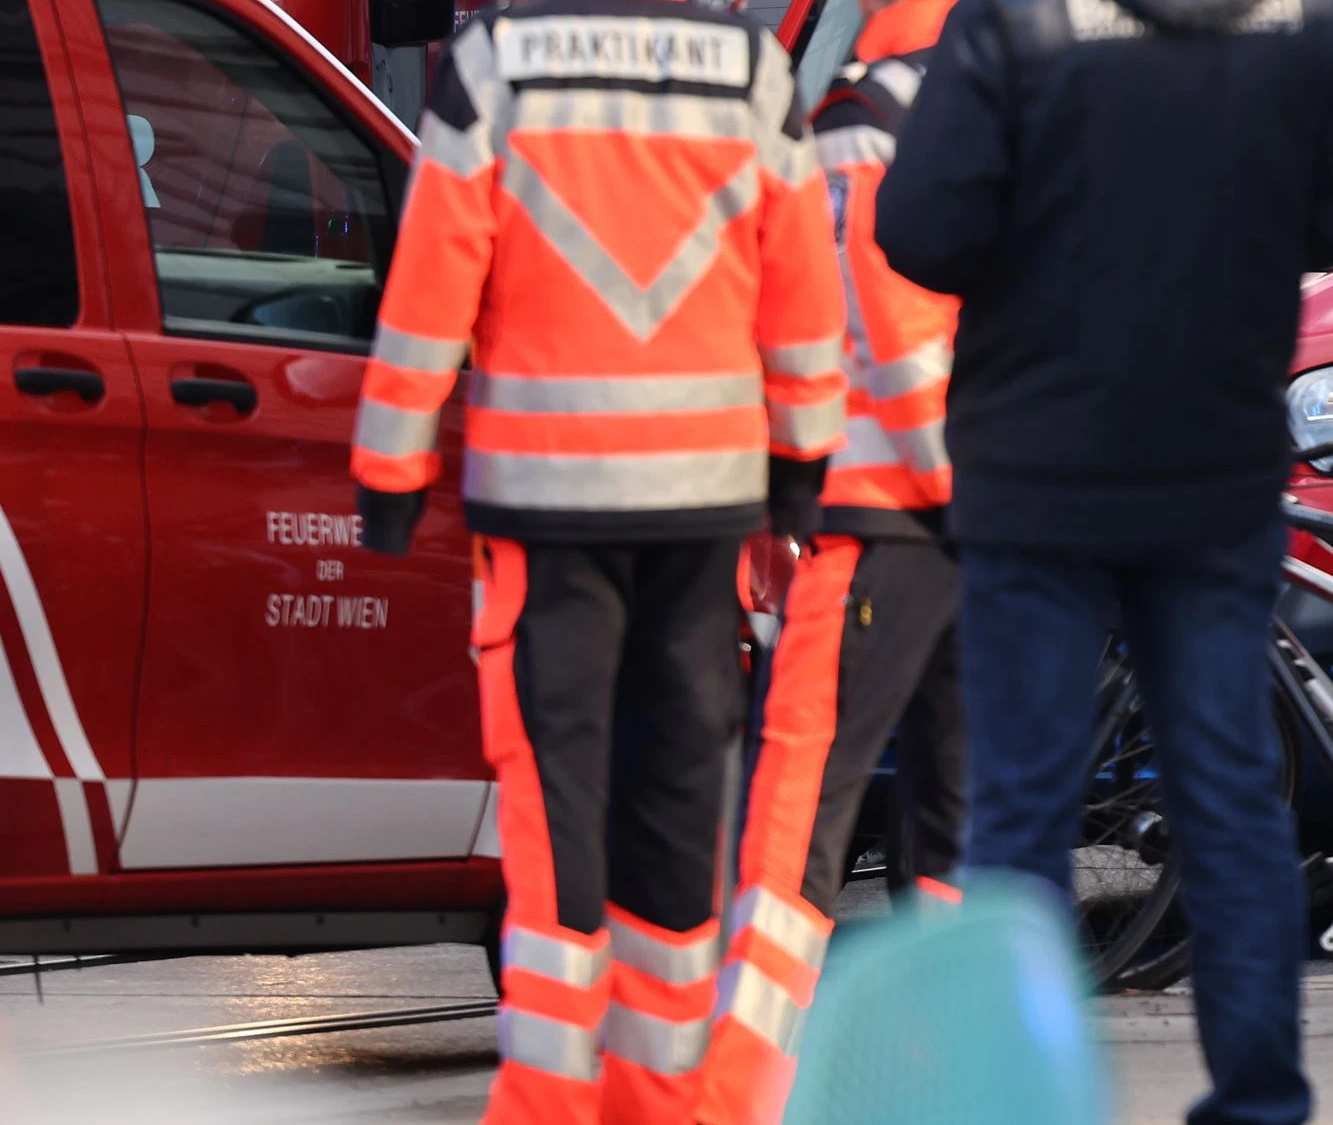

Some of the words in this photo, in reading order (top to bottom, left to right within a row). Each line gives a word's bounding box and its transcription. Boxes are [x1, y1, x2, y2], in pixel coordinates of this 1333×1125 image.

[519, 27, 725, 69] PRAKTIKANT
[265, 510, 364, 547] FEUERWE
[315, 559, 345, 581] DER
[264, 593, 335, 627] STADT
[336, 596, 389, 629] WIEN
